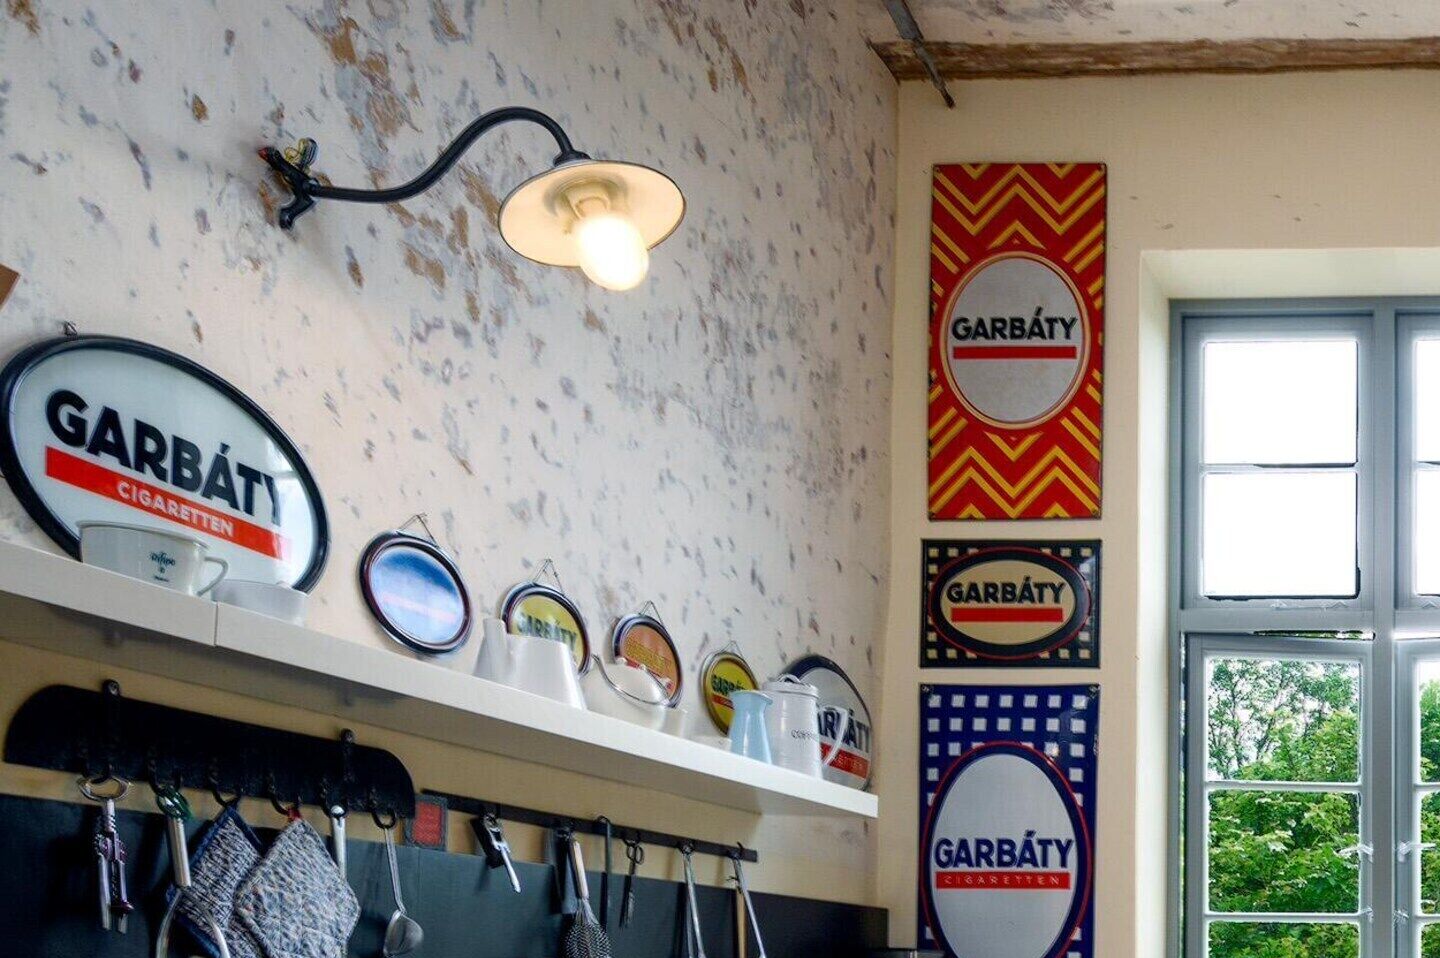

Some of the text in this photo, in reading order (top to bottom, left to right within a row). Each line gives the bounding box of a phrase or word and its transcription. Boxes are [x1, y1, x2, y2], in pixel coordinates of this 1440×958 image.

[951, 305, 1078, 342] GARBÁTY
[45, 389, 282, 527] GARBÁTY
[116, 480, 236, 538] CIGARETTEN
[946, 575, 1065, 605] GARBÁTY
[934, 829, 1074, 869] GARBÁTY
[942, 873, 1061, 886] CIGARETTEN
